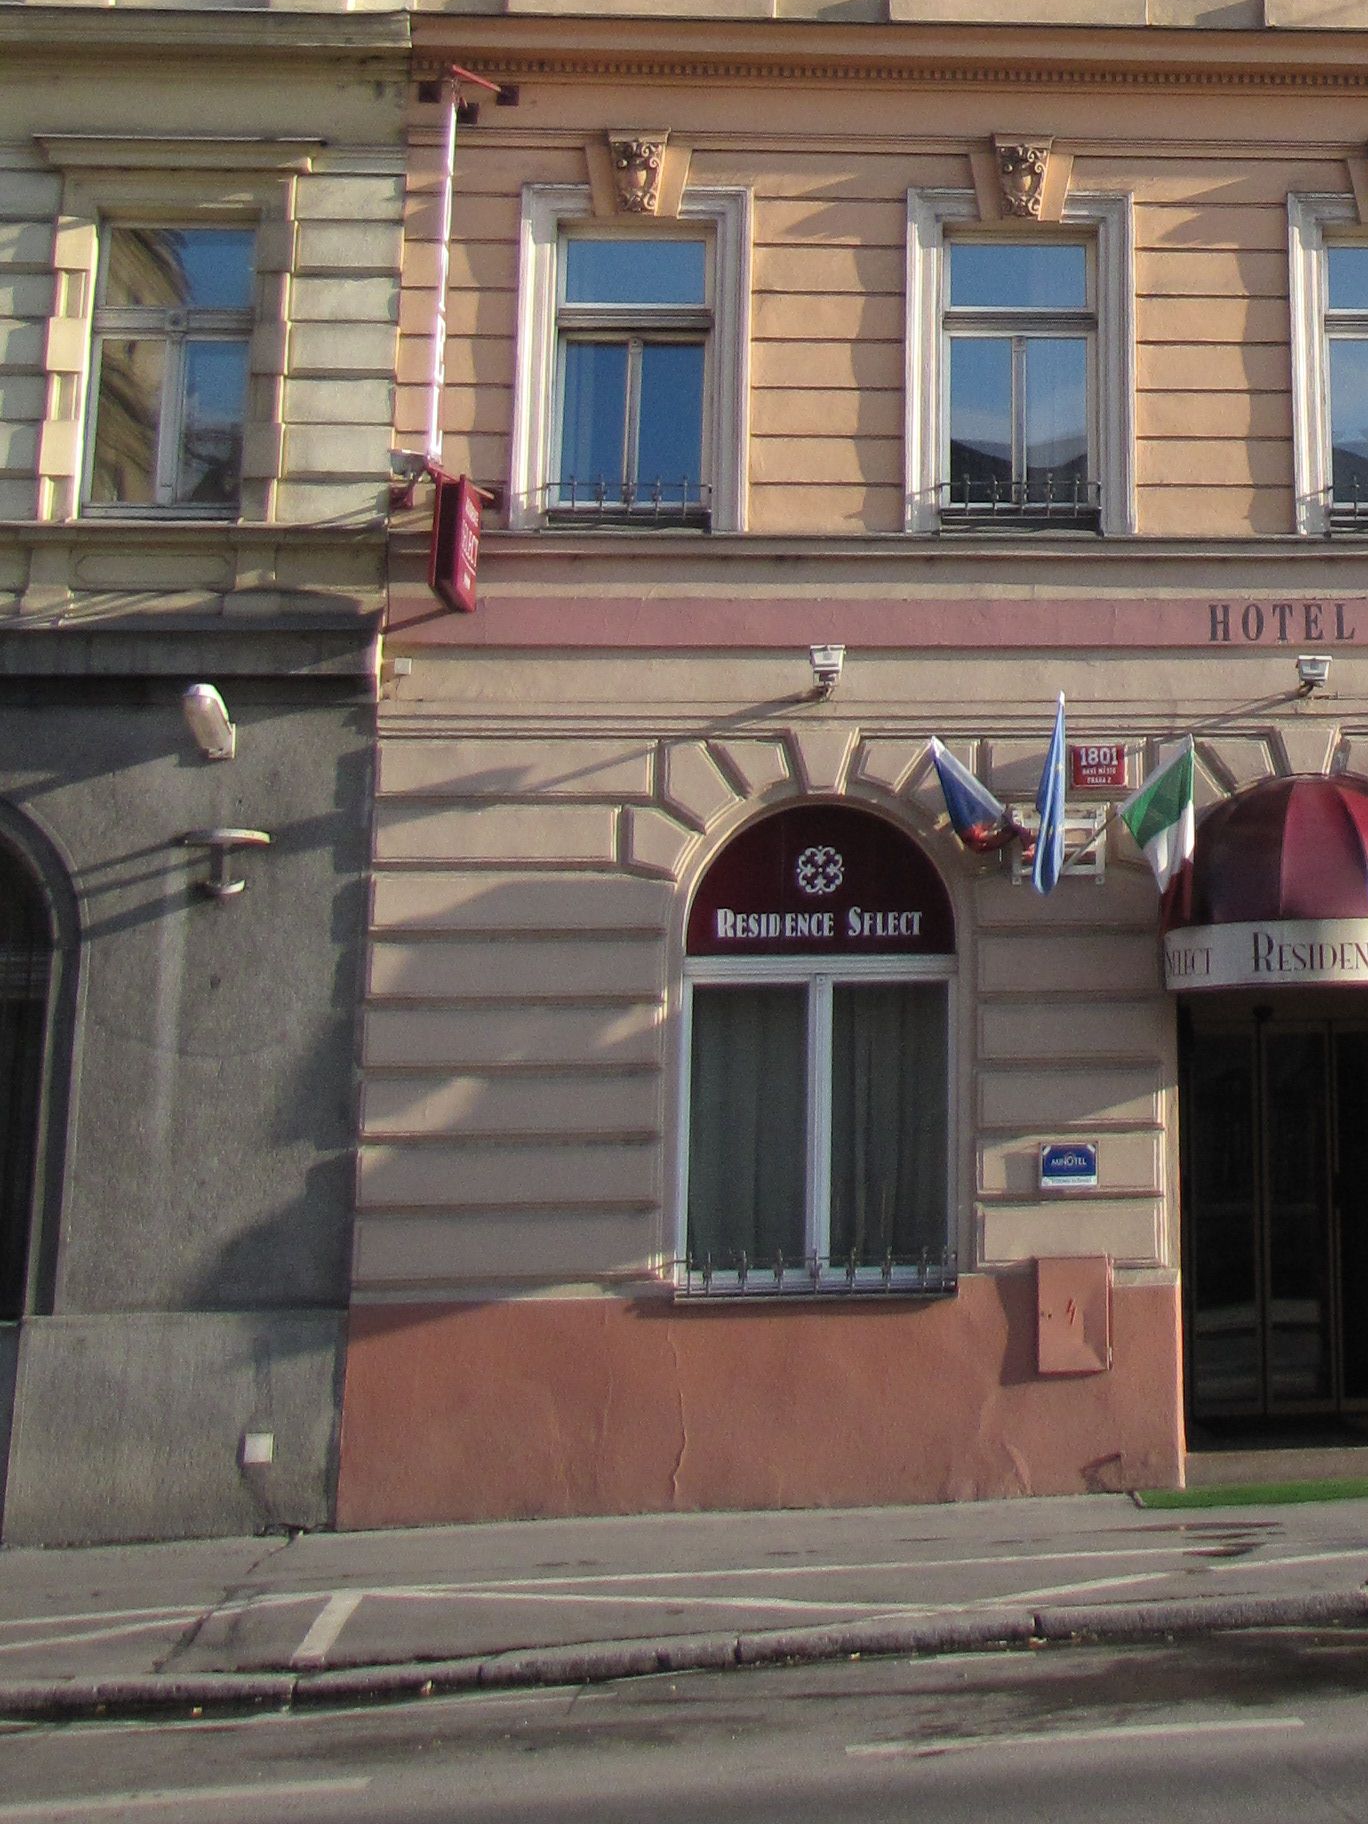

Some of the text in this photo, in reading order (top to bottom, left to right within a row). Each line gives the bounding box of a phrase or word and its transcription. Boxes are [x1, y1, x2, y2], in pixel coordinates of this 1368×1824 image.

[1208, 602, 1356, 642] HOTEL
[1080, 747, 1118, 766] 1801
[716, 906, 923, 938] RESIDENCE SELECT
